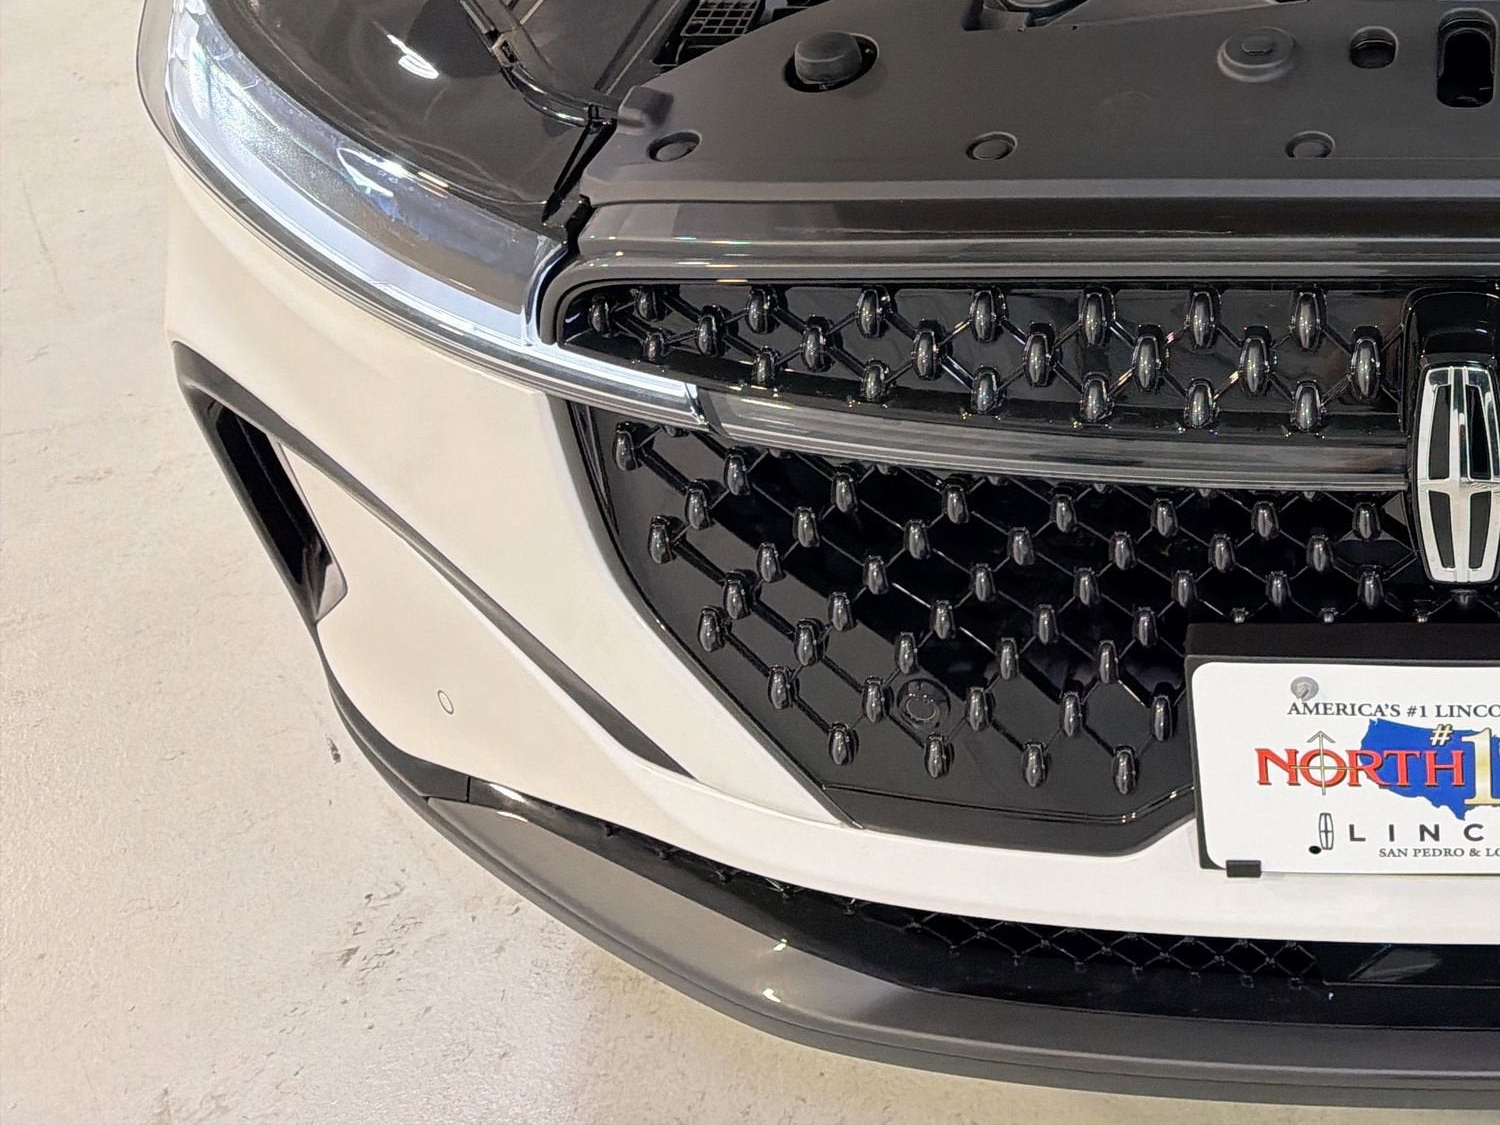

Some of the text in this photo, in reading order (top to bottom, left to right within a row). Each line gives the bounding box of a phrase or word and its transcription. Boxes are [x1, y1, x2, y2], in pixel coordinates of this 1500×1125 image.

[1287, 702, 1401, 717] AMERICA'S
[1407, 705, 1428, 718] #1
[1255, 748, 1466, 787] NORTH
[1378, 848, 1408, 858] SAN
[1413, 848, 1465, 858] PEDRO
[1469, 848, 1481, 858] &
